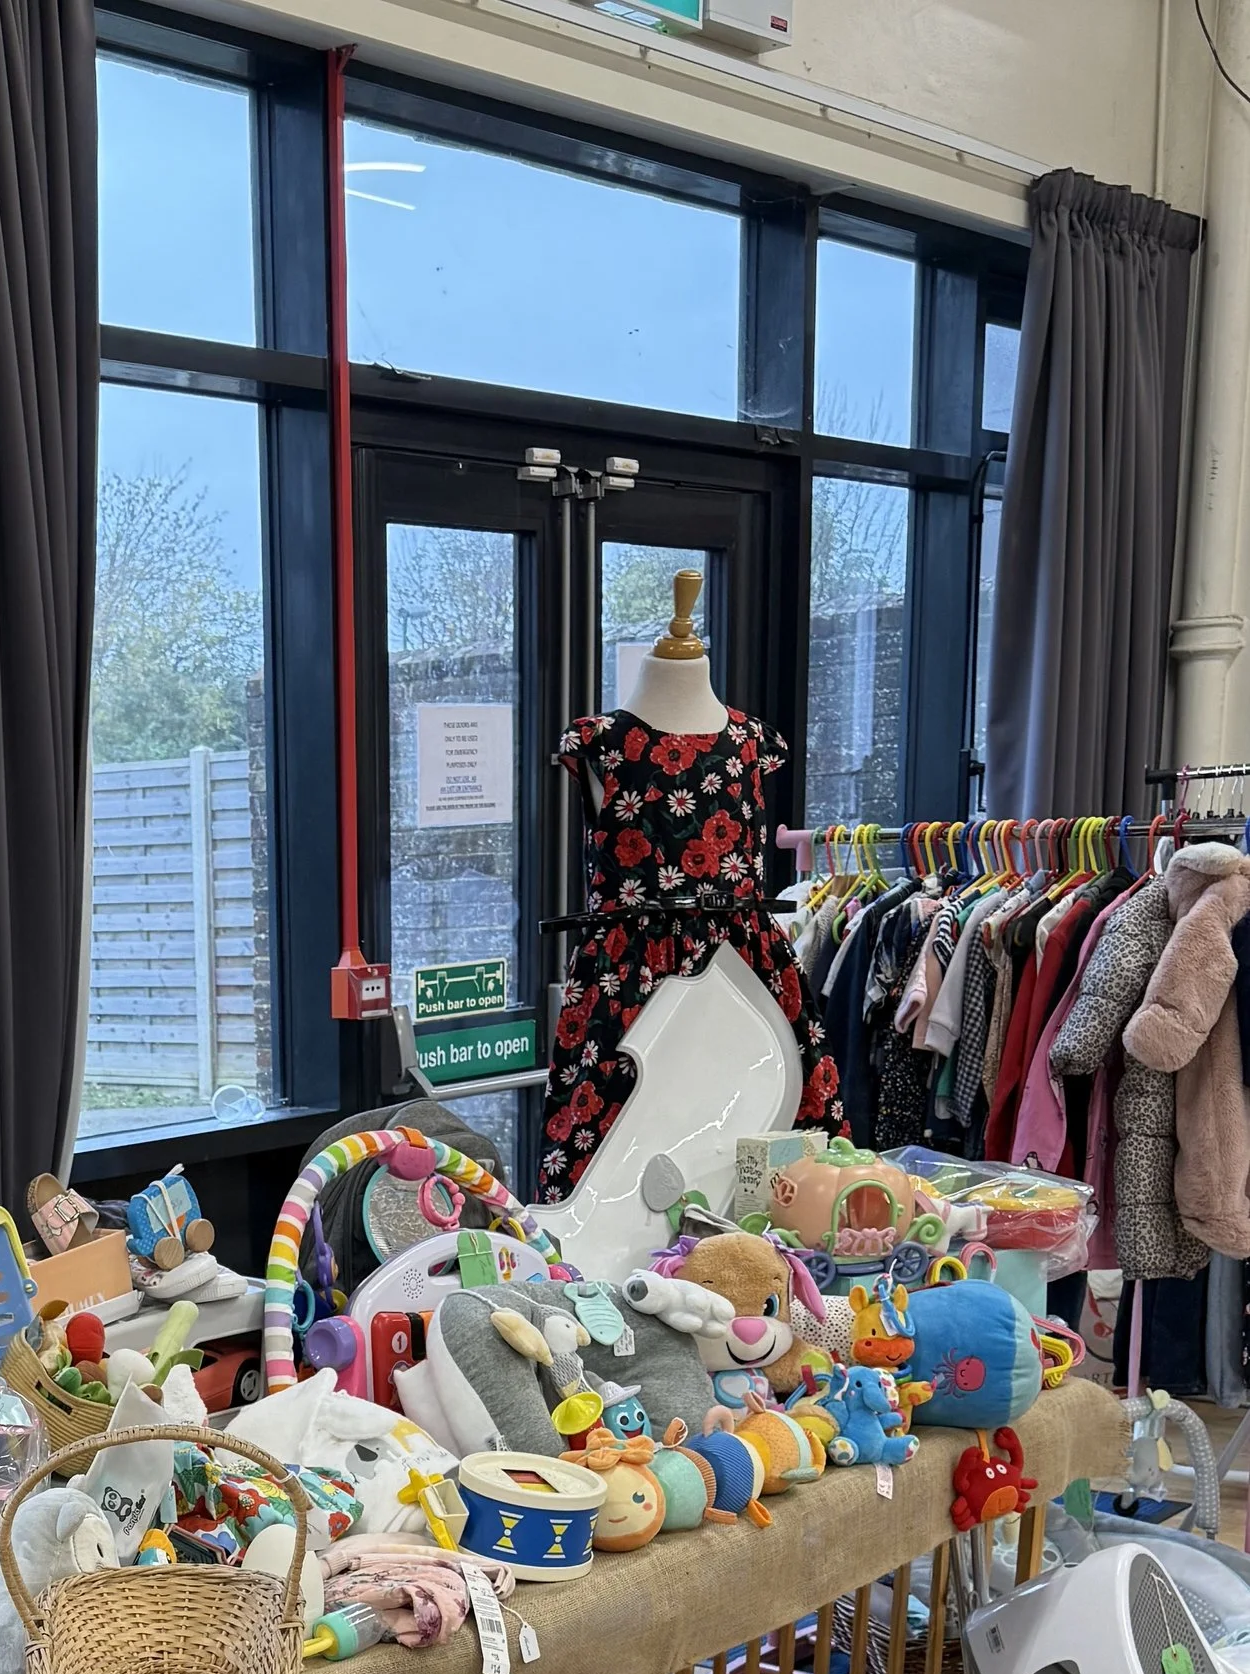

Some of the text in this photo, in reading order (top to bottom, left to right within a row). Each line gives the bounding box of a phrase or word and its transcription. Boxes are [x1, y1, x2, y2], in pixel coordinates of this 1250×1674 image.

[418, 995, 503, 1014] Push bar to open
[415, 1036, 529, 1069] ush bar to open
